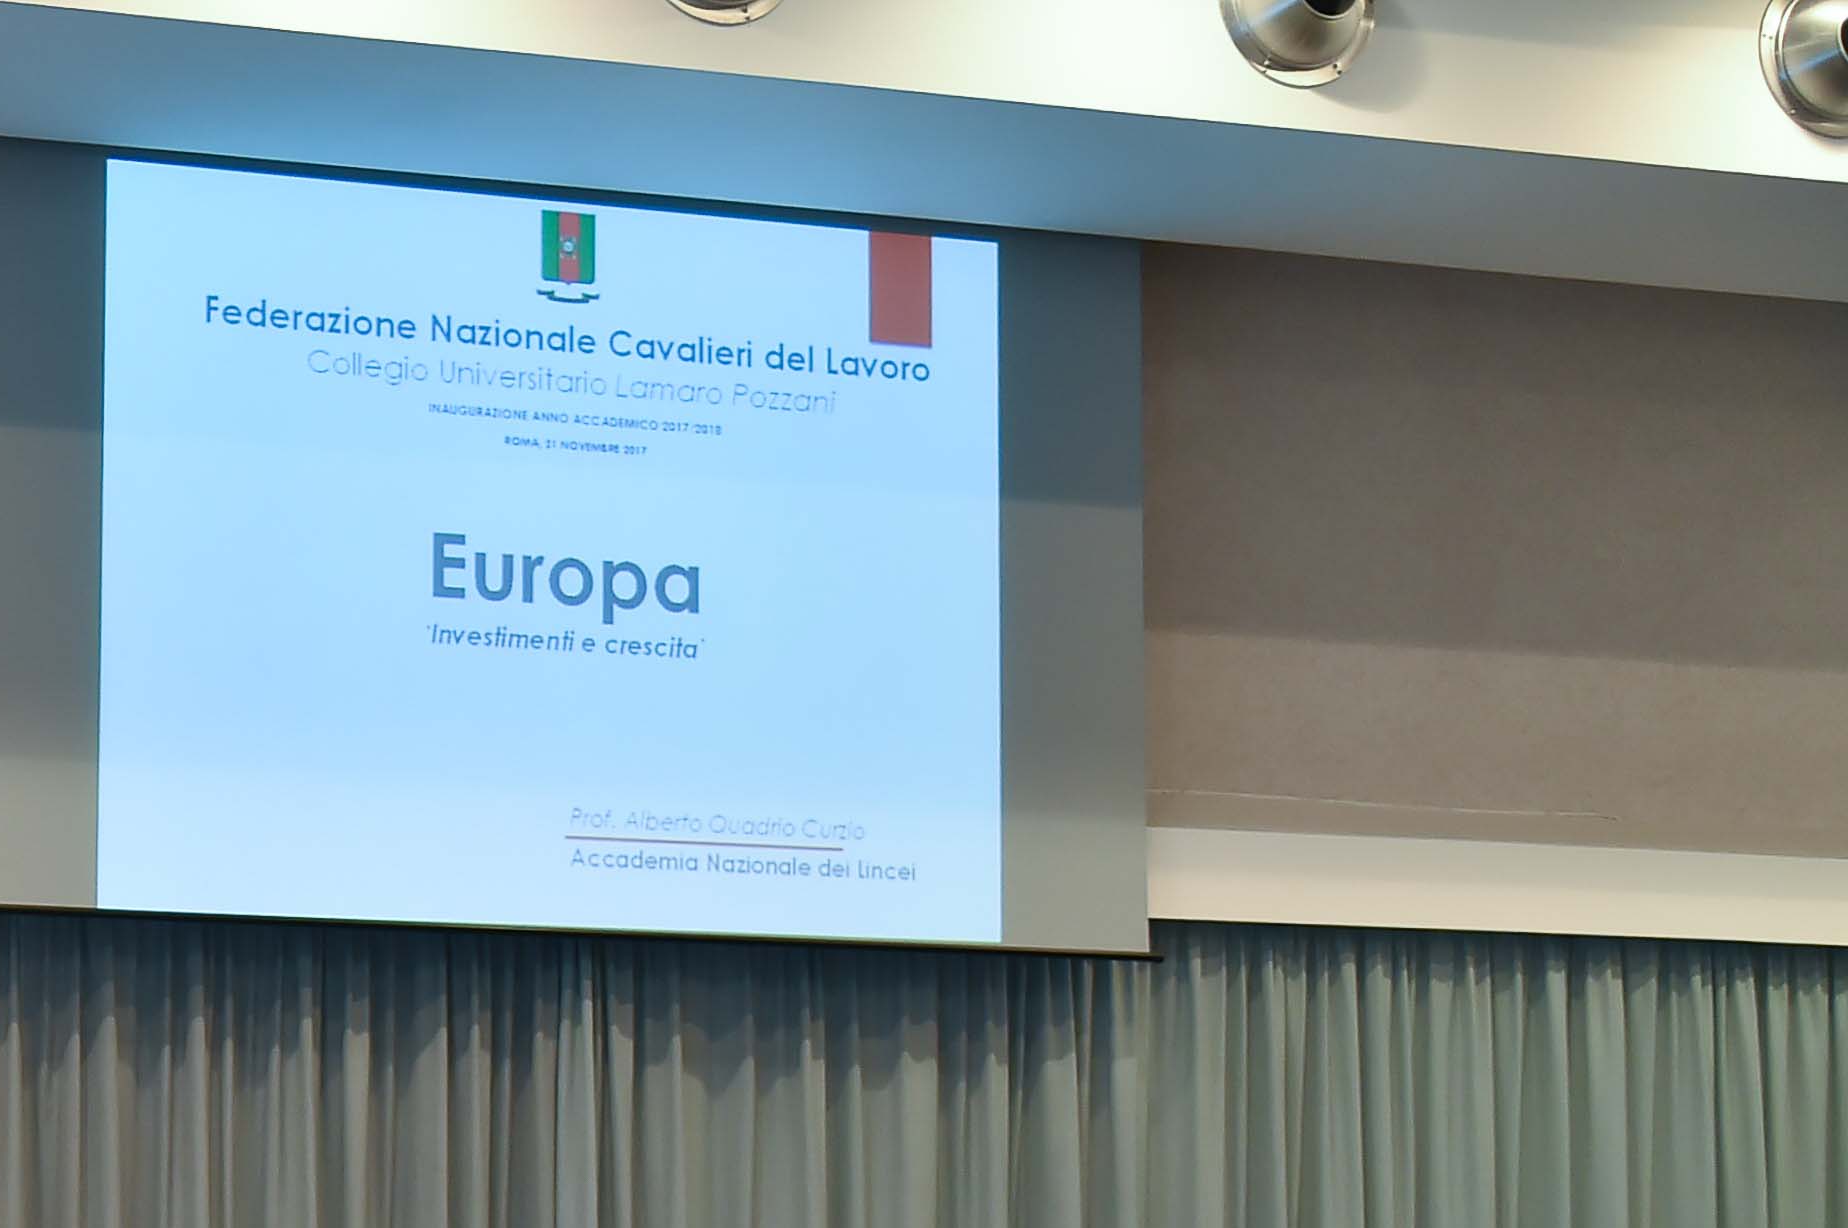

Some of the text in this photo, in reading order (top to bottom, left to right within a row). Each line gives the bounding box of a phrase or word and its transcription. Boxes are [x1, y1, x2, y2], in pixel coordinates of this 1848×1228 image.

[206, 295, 930, 382] Federazione Nazionale Cavalieri del Lavoro
[307, 349, 836, 415] Collegio Universitario Lamaro Pozzani
[428, 403, 528, 421] INAUGURAZIONE
[533, 411, 568, 424] ANNO
[573, 414, 657, 431] ACCADEMICO
[503, 435, 543, 449] ROMA,
[560, 440, 620, 454] NOVEMBRE
[623, 444, 647, 455] 2017
[432, 532, 700, 625] Europa
[581, 637, 596, 652] e
[570, 807, 866, 841] Prof. Alberto Quadrio Curzio
[570, 848, 916, 881] Accademia Nazionale dei Lincei
